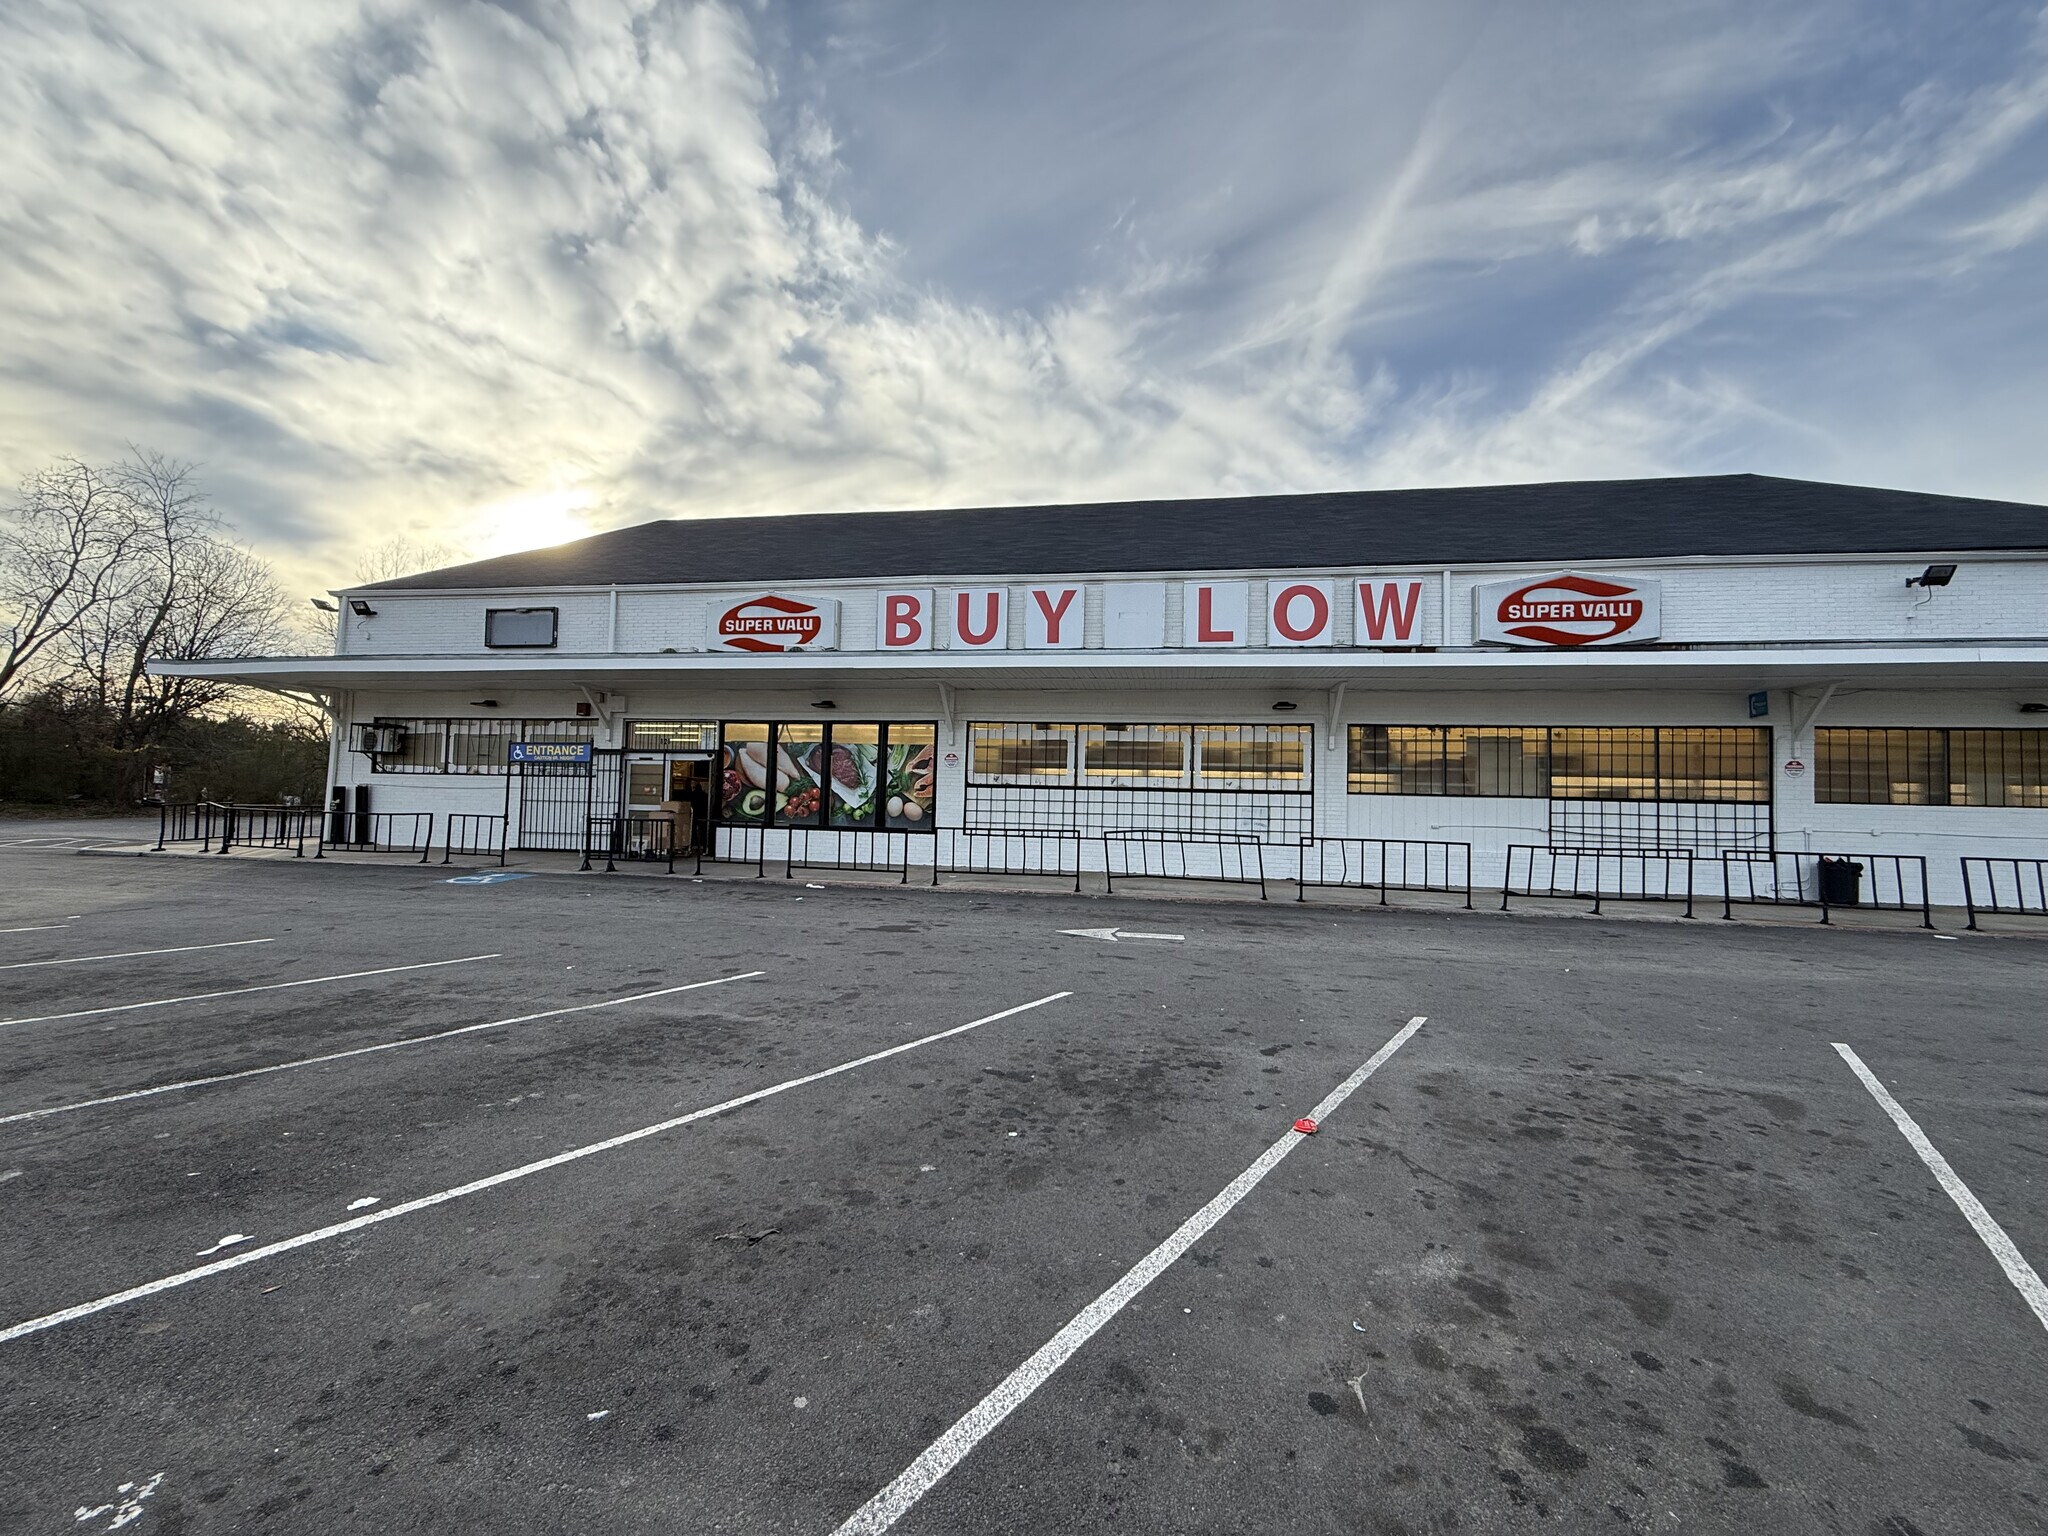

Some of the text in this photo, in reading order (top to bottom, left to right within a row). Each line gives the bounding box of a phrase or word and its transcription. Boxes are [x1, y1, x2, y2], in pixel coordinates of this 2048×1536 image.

[885, 582, 1422, 646] BUY LOW
[1508, 602, 1633, 619] SUPER VALU
[725, 618, 813, 632] SUPER VALU
[526, 745, 584, 756] ENTRANCE
